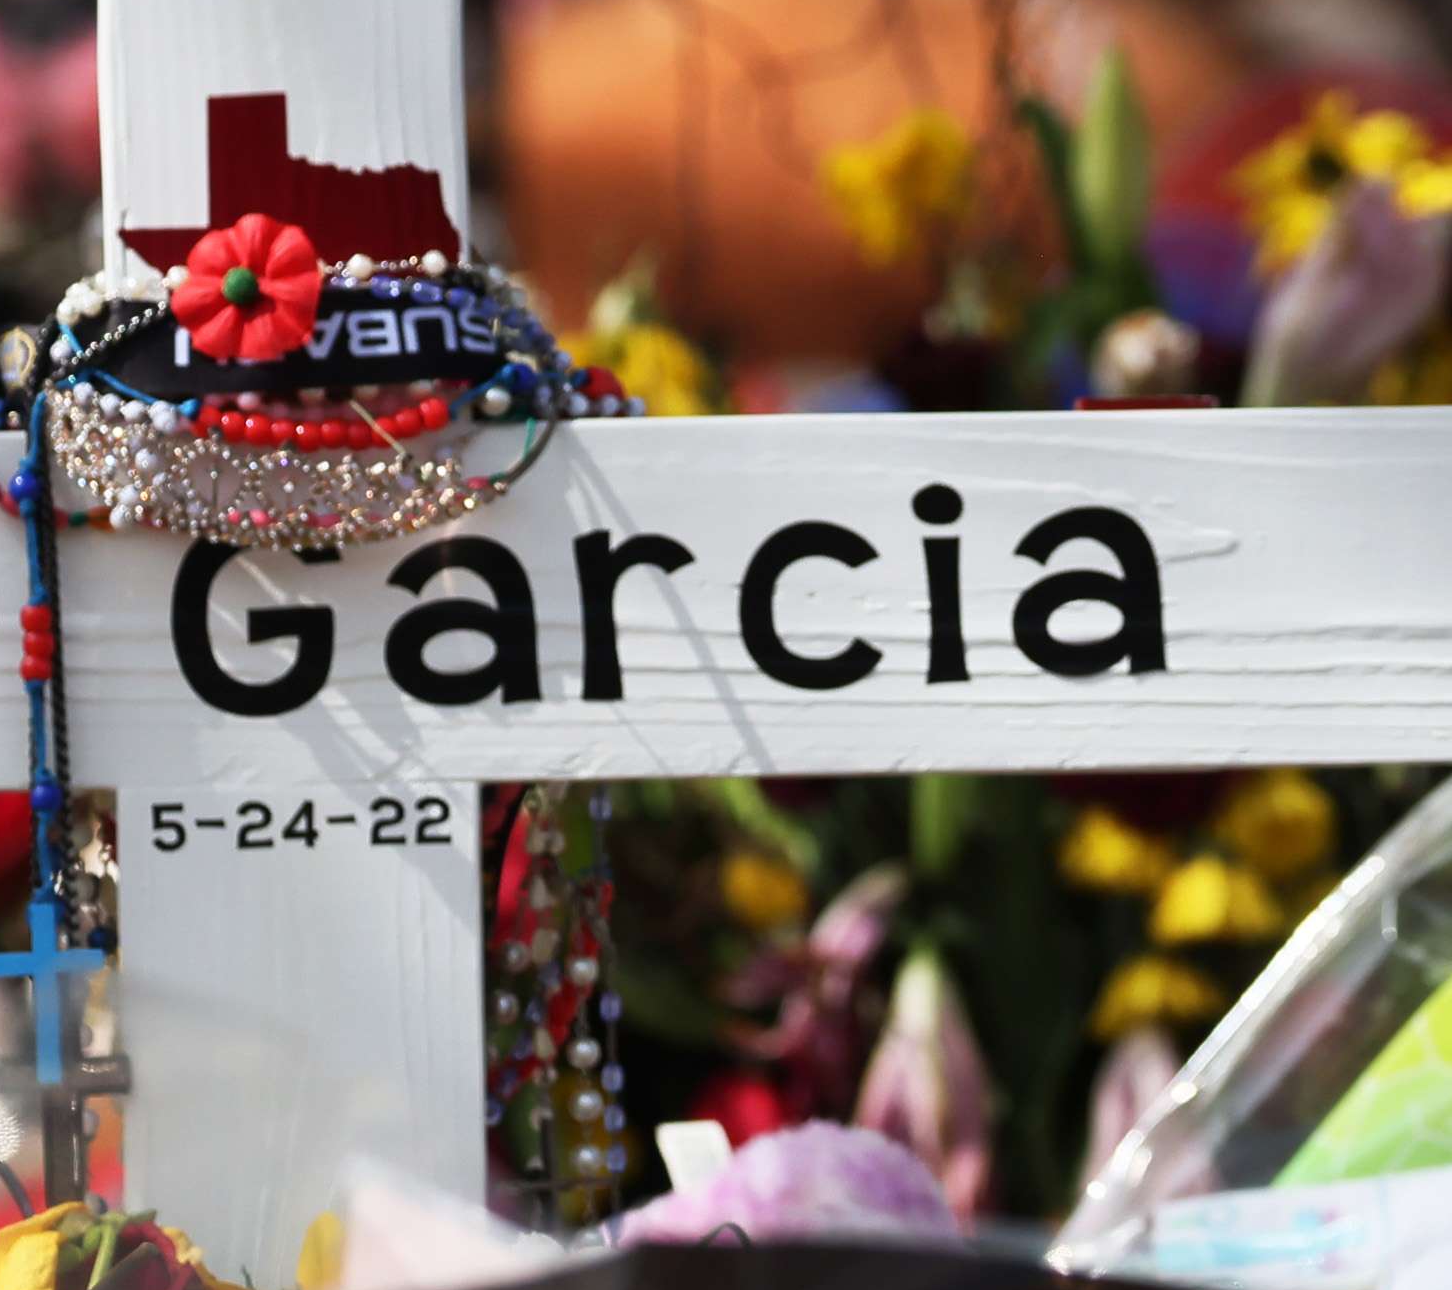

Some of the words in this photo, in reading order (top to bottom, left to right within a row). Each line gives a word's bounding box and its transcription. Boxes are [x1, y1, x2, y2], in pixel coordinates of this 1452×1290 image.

[174, 307, 496, 367] SUBA
[171, 482, 1166, 716] Garcia
[151, 796, 451, 851] 5-24-22
